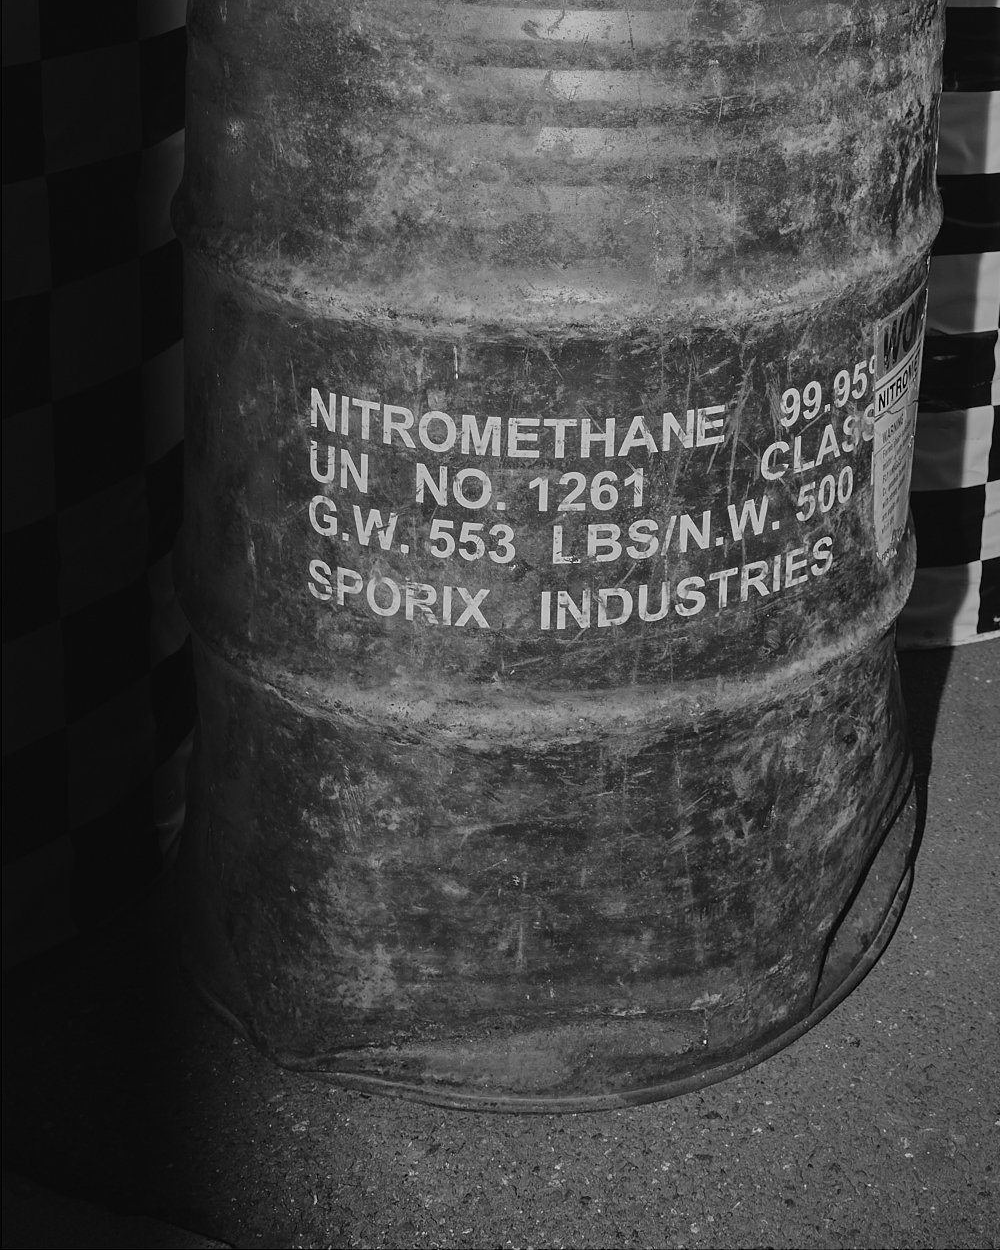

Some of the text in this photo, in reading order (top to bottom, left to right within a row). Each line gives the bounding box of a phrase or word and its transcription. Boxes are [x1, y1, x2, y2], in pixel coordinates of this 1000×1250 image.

[309, 387, 726, 459] NITROMETHANE
[308, 495, 410, 555] G.W.
[429, 519, 516, 565] 553
[796, 465, 854, 524] 500
[309, 440, 369, 494] UN
[415, 462, 507, 511] NO.
[528, 467, 645, 513] 1261
[307, 536, 834, 631] SPORIX INDUSTRIES
